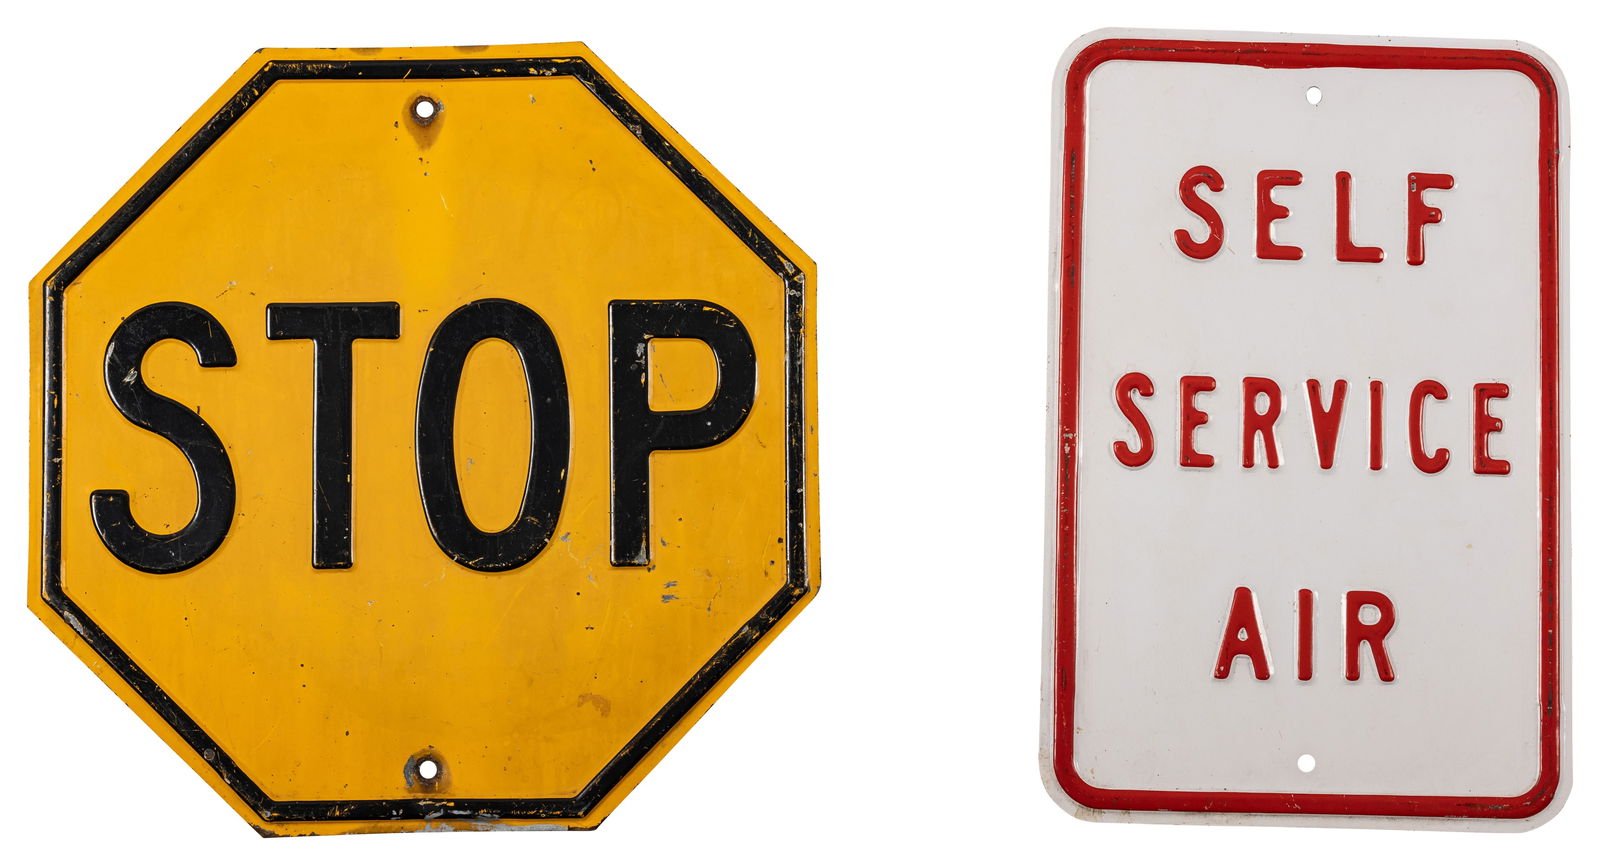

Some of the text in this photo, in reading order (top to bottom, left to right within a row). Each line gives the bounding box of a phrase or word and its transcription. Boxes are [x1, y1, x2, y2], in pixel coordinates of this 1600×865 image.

[1174, 165, 1455, 266] SELF
[90, 298, 757, 574] STOP
[1113, 371, 1511, 476] SERVICE
[1214, 586, 1396, 683] AIR
